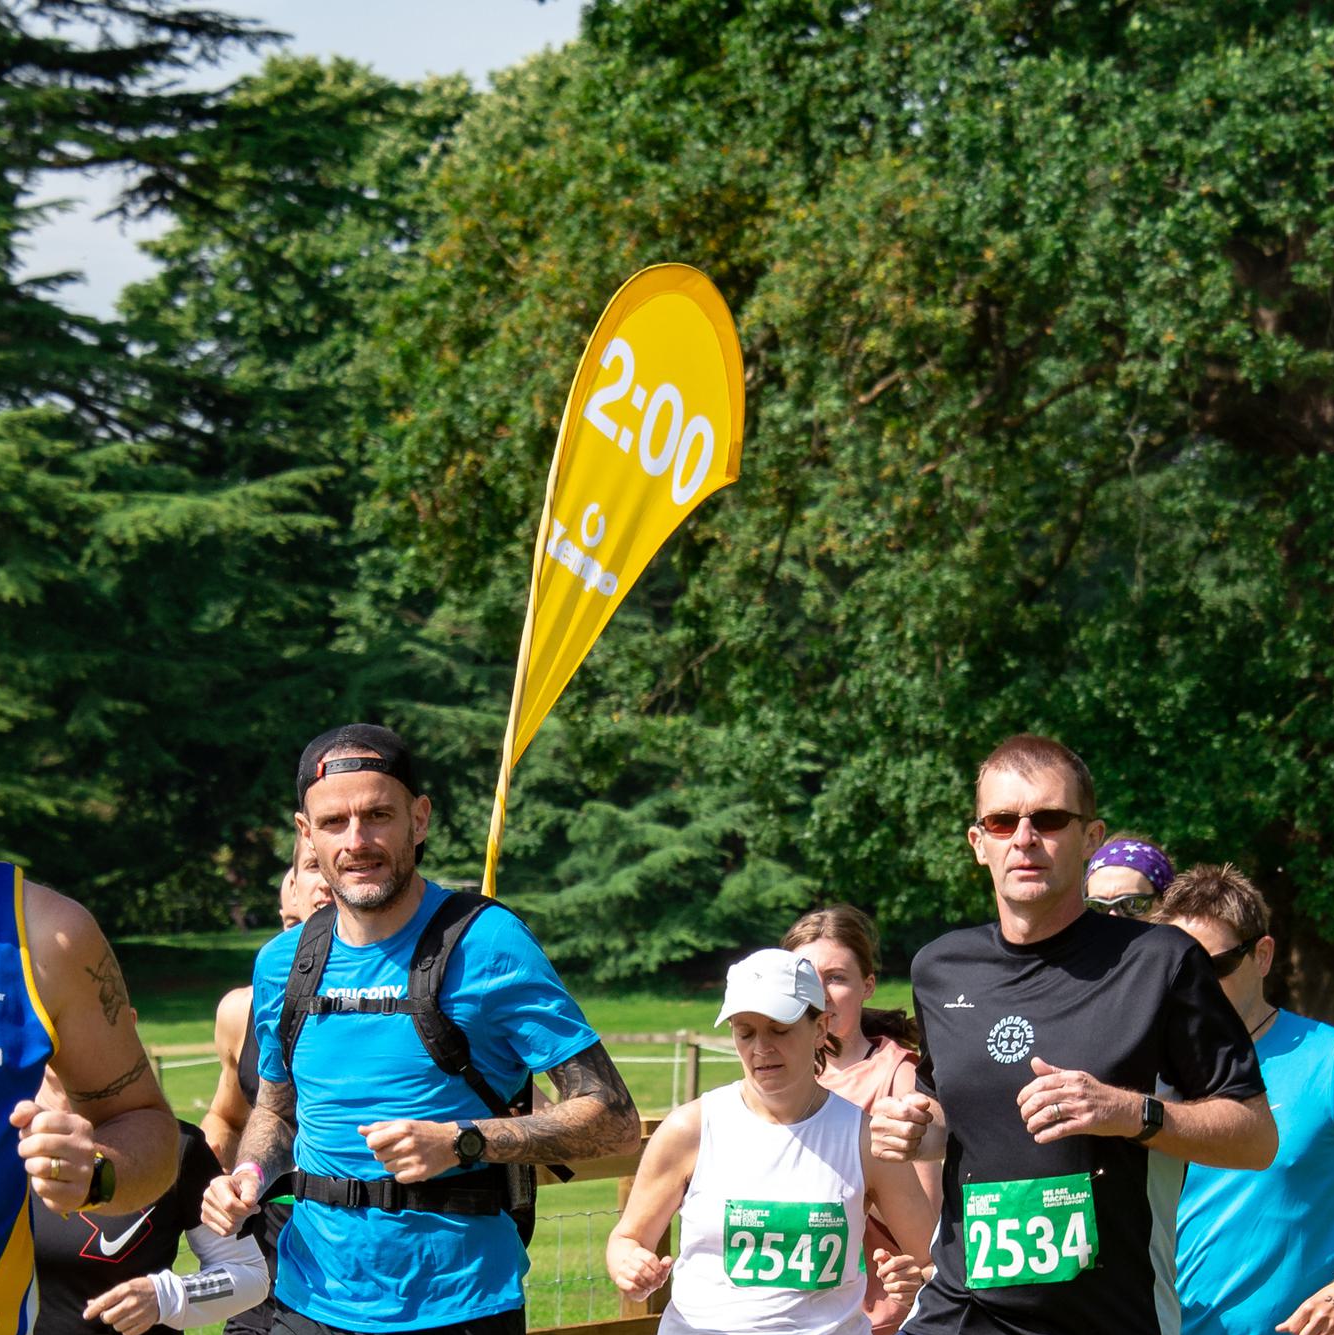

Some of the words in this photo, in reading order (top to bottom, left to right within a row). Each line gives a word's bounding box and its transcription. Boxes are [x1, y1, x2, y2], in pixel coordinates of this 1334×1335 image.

[583, 337, 714, 505] 2:00
[327, 984, 402, 999] saucony
[989, 1016, 1034, 1038] SANDBACH
[987, 1044, 1030, 1063] STRIDERS
[730, 1231, 842, 1282] 2542
[969, 1212, 1092, 1278] 2534
